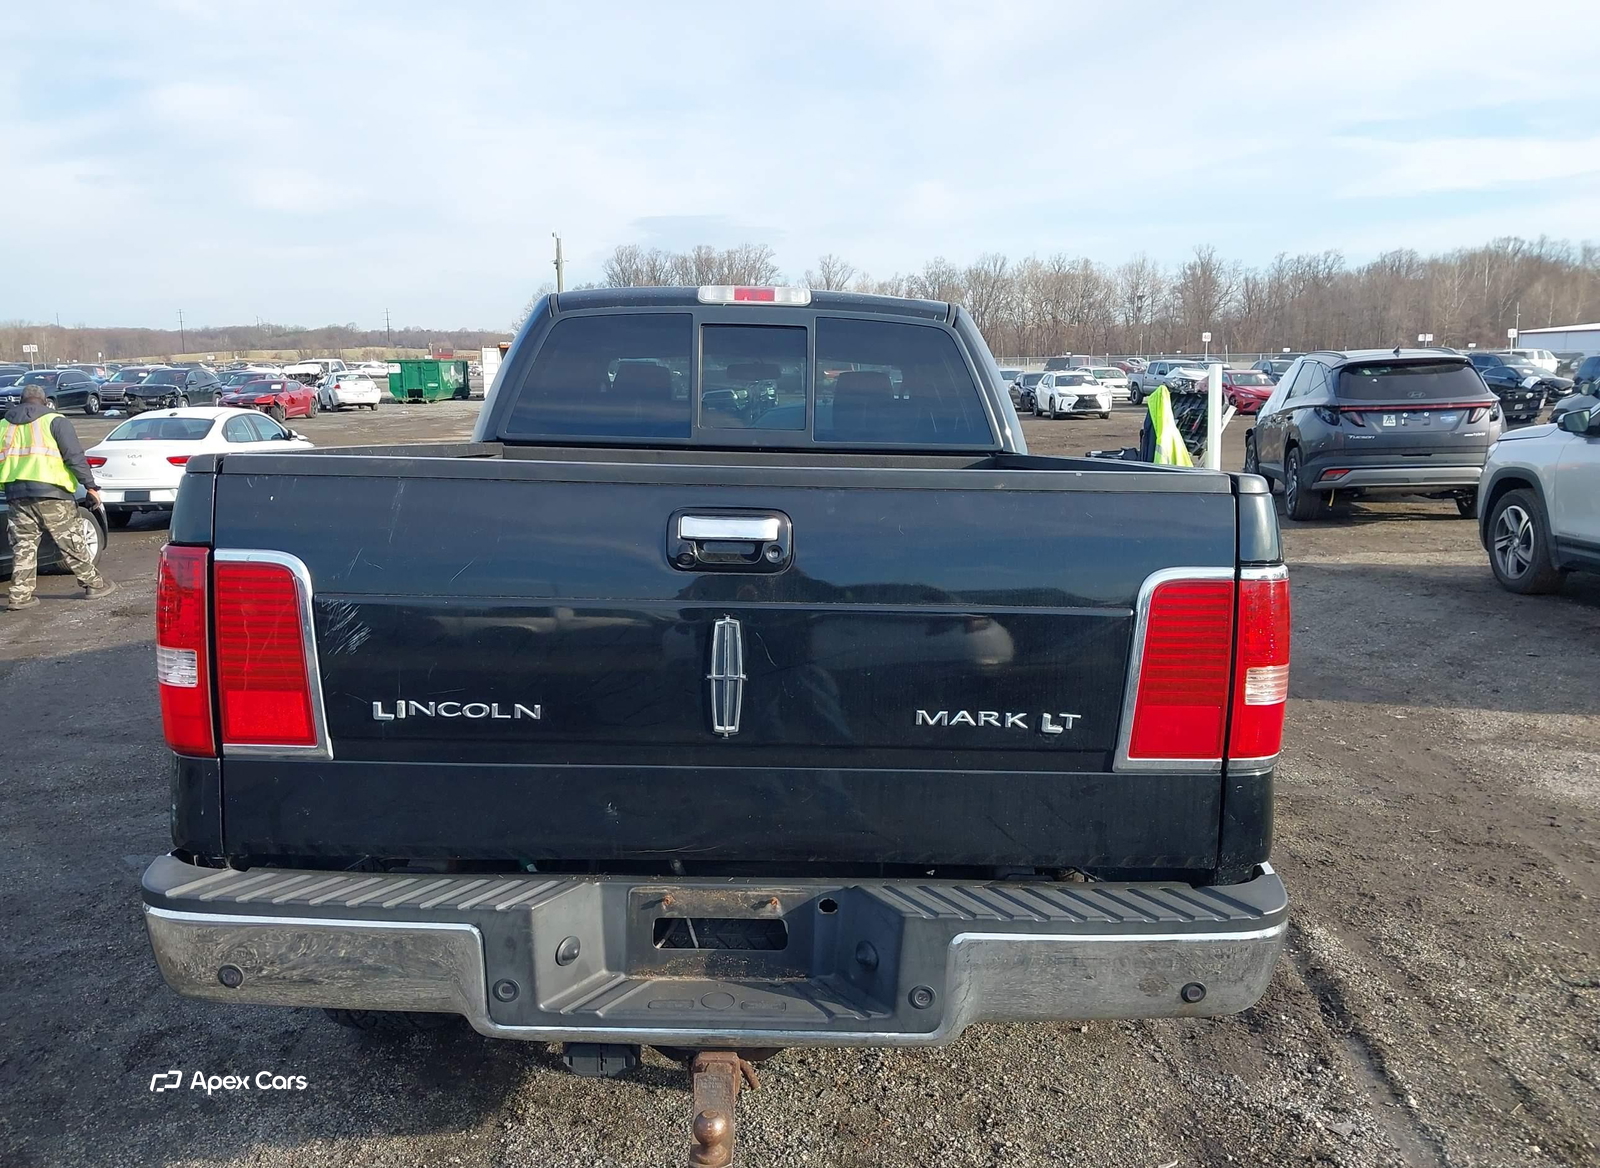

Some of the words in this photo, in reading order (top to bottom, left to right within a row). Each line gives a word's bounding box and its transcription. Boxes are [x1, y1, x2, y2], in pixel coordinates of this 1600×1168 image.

[372, 699, 541, 721] LINCOLN
[916, 710, 1028, 729] MARK
[1041, 712, 1082, 733] LT
